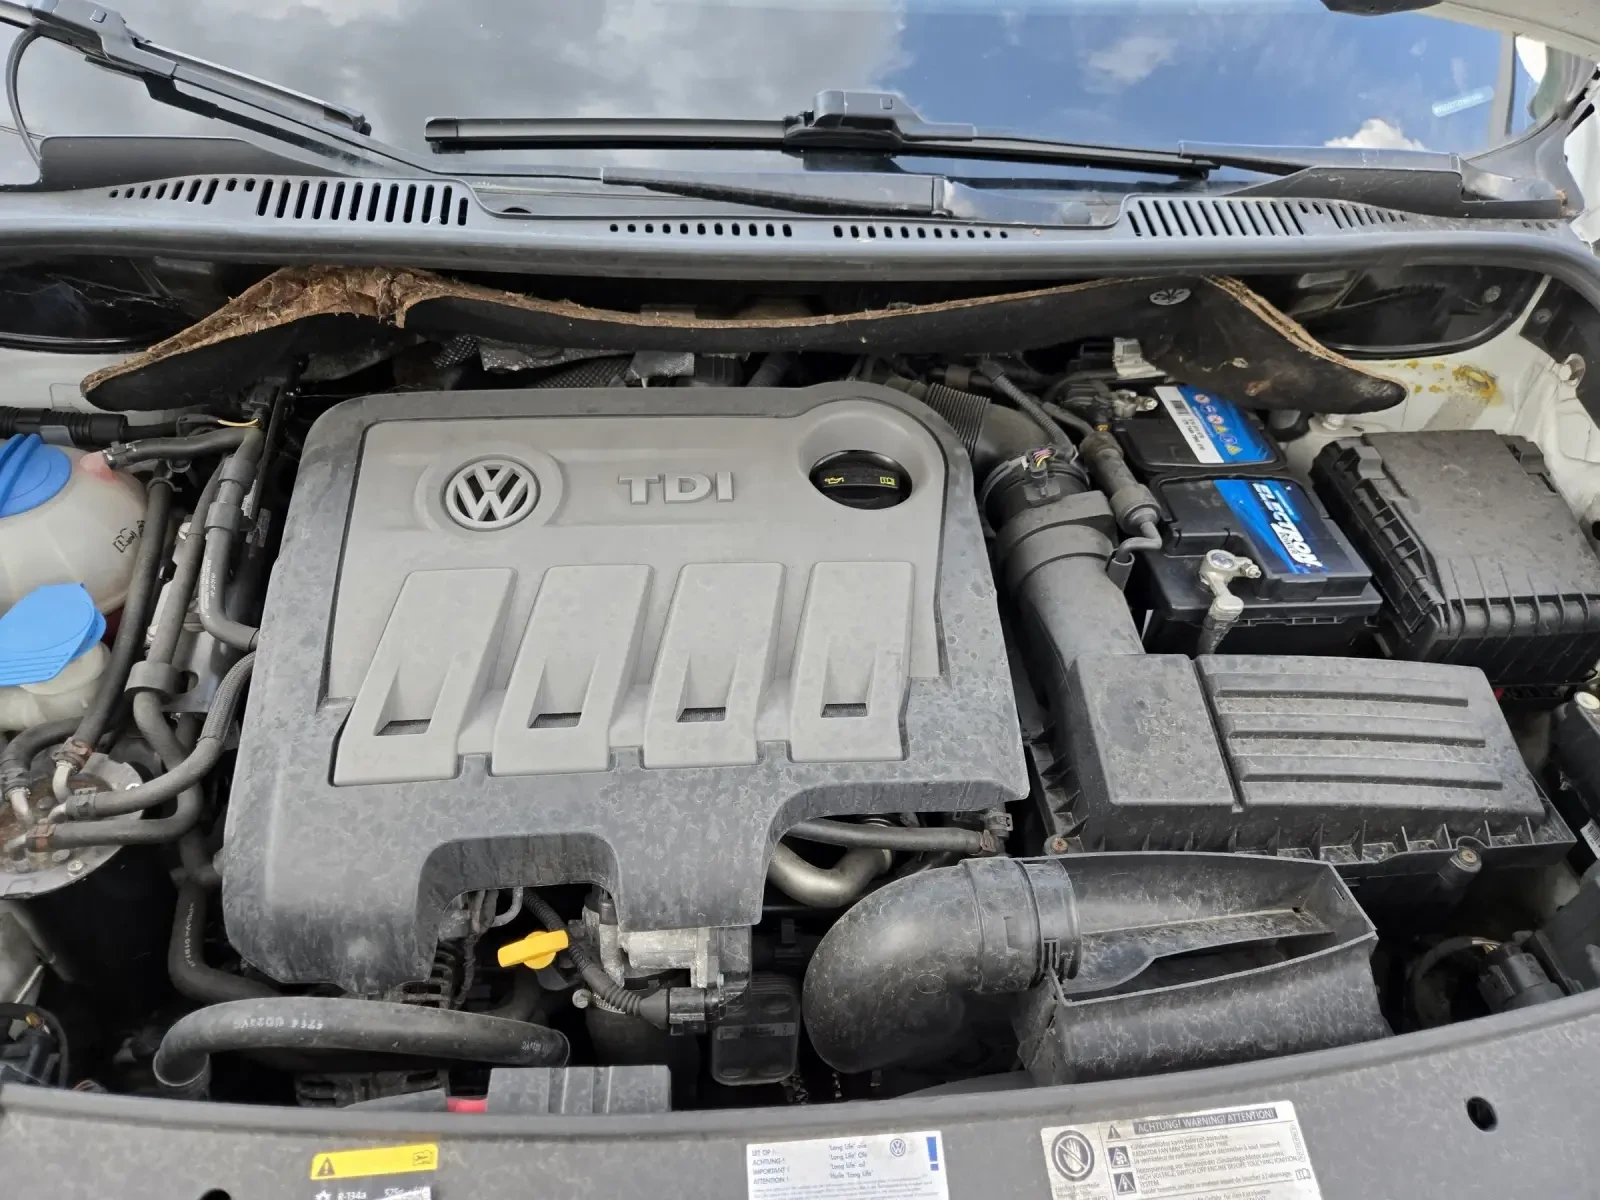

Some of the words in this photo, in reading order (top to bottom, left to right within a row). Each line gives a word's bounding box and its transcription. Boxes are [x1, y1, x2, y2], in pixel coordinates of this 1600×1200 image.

[618, 471, 735, 505] TDI
[1252, 483, 1323, 567] ELECTRON
[1138, 1119, 1181, 1133] ACHTUNG!
[1182, 1114, 1225, 1128] WARNING!
[1227, 1108, 1275, 1123] ATTENTION!
